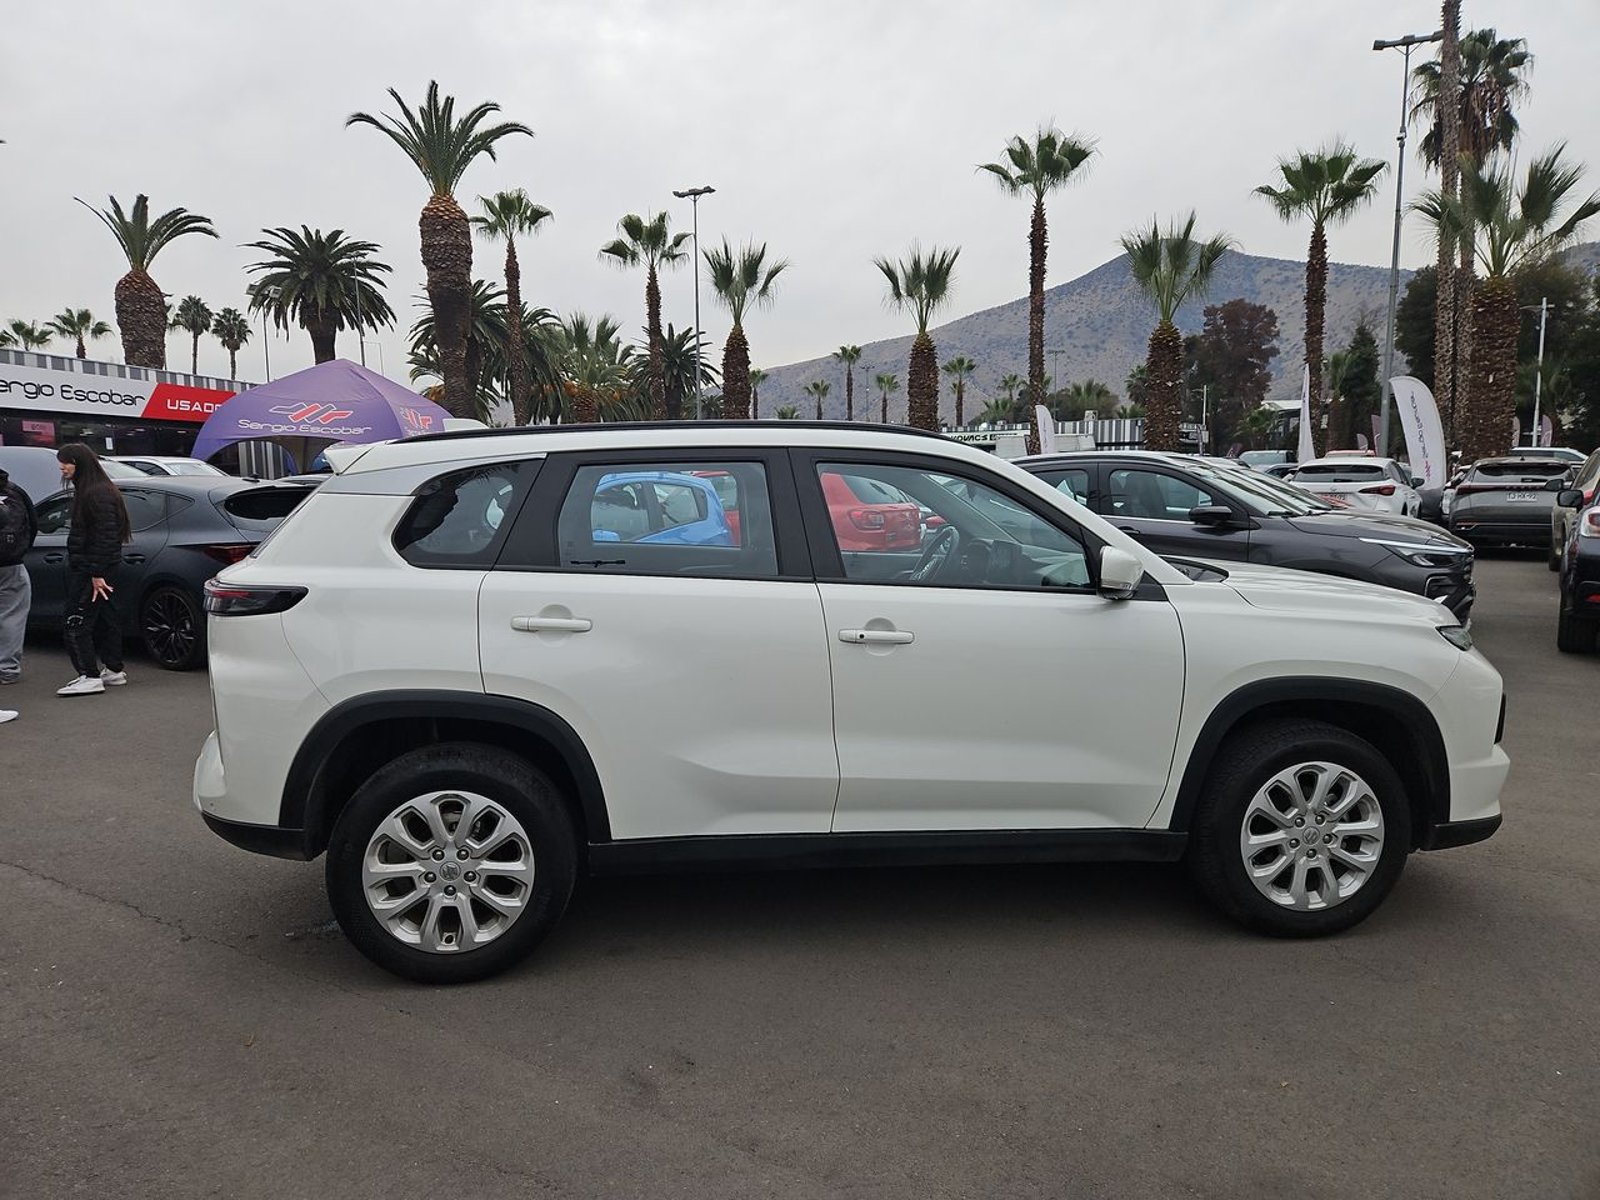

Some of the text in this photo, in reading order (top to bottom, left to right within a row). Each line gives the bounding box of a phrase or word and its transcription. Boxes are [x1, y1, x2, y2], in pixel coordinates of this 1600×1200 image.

[0, 379, 146, 406] ergio Escobar
[238, 419, 372, 435] Sergio Escobar
